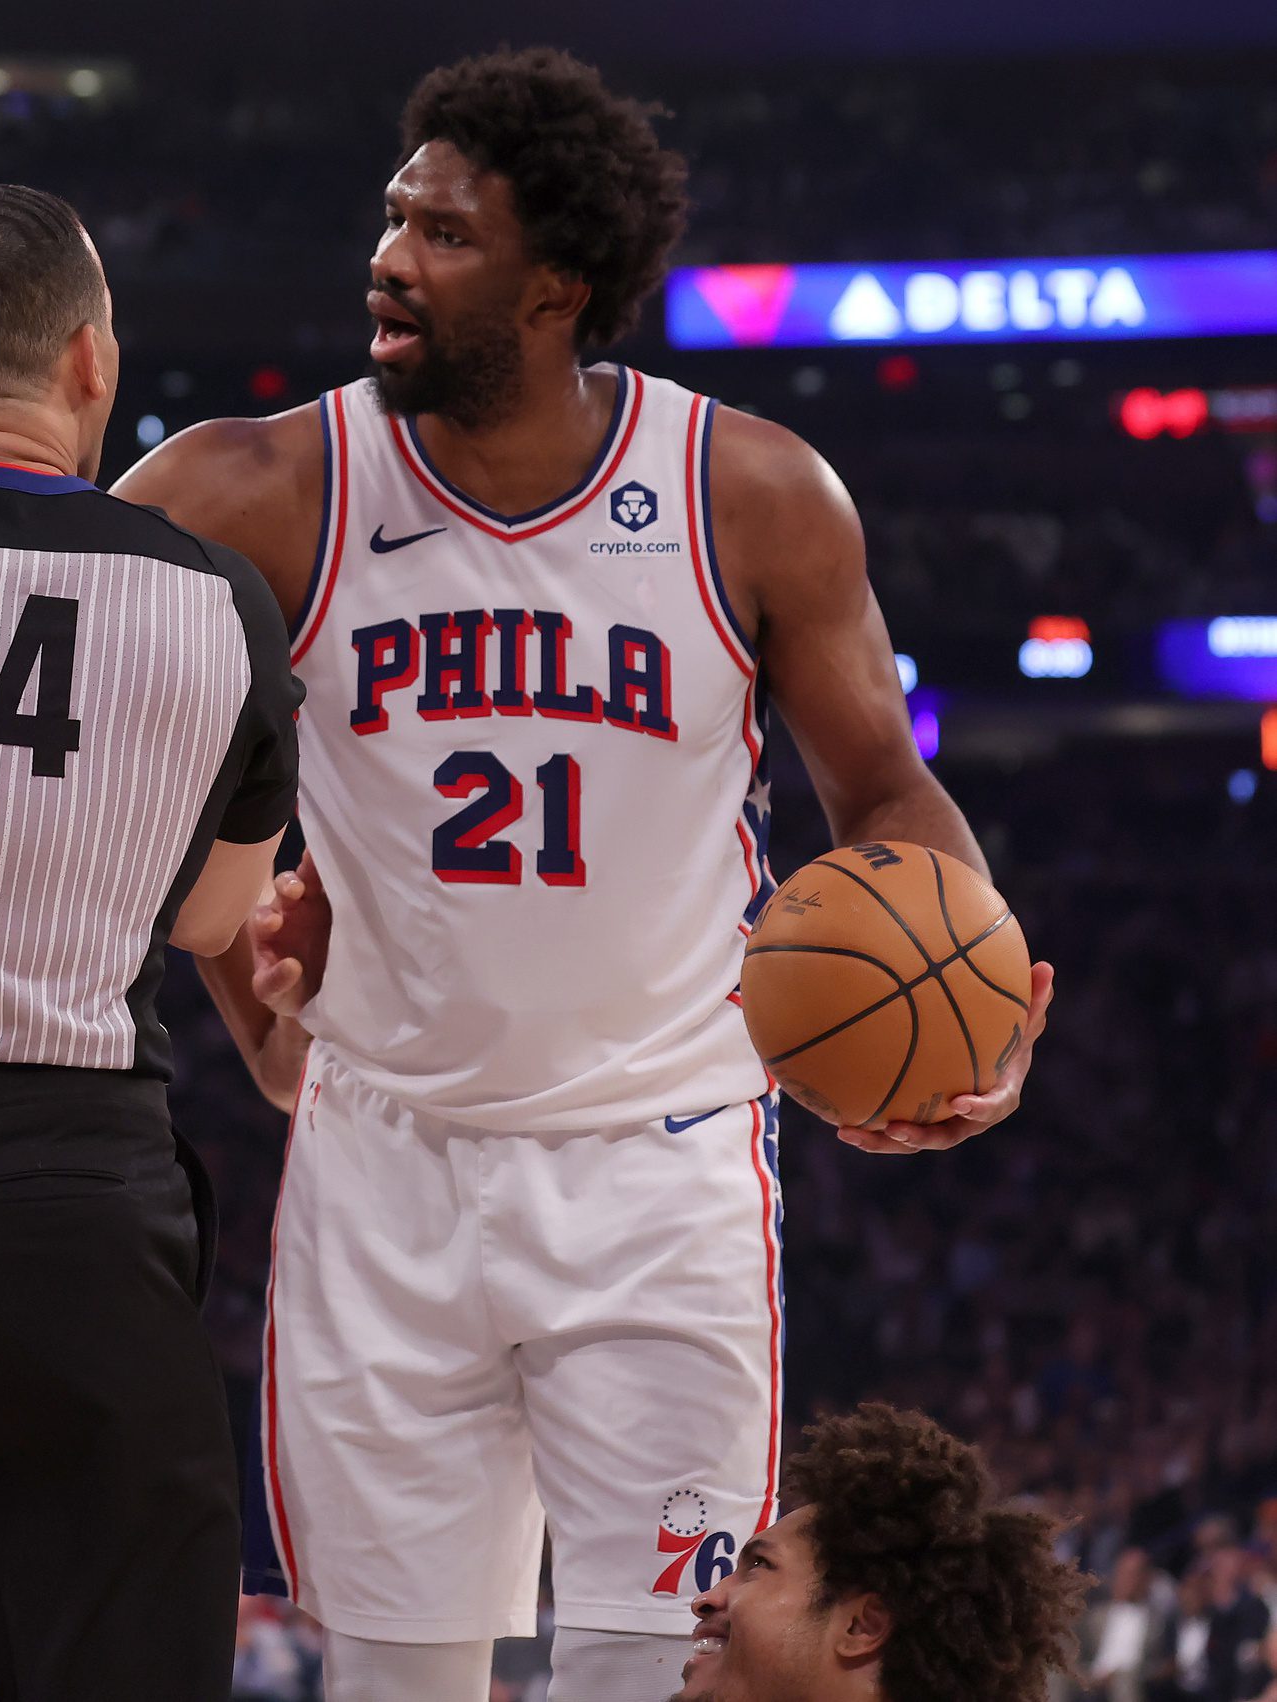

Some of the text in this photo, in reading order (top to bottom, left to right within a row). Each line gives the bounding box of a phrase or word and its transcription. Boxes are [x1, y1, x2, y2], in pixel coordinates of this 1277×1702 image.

[903, 267, 1147, 334] DELTA
[590, 541, 680, 555] crypto.com
[350, 608, 678, 742] PHILA
[432, 751, 586, 887] 21
[652, 1525, 735, 1595] 76
